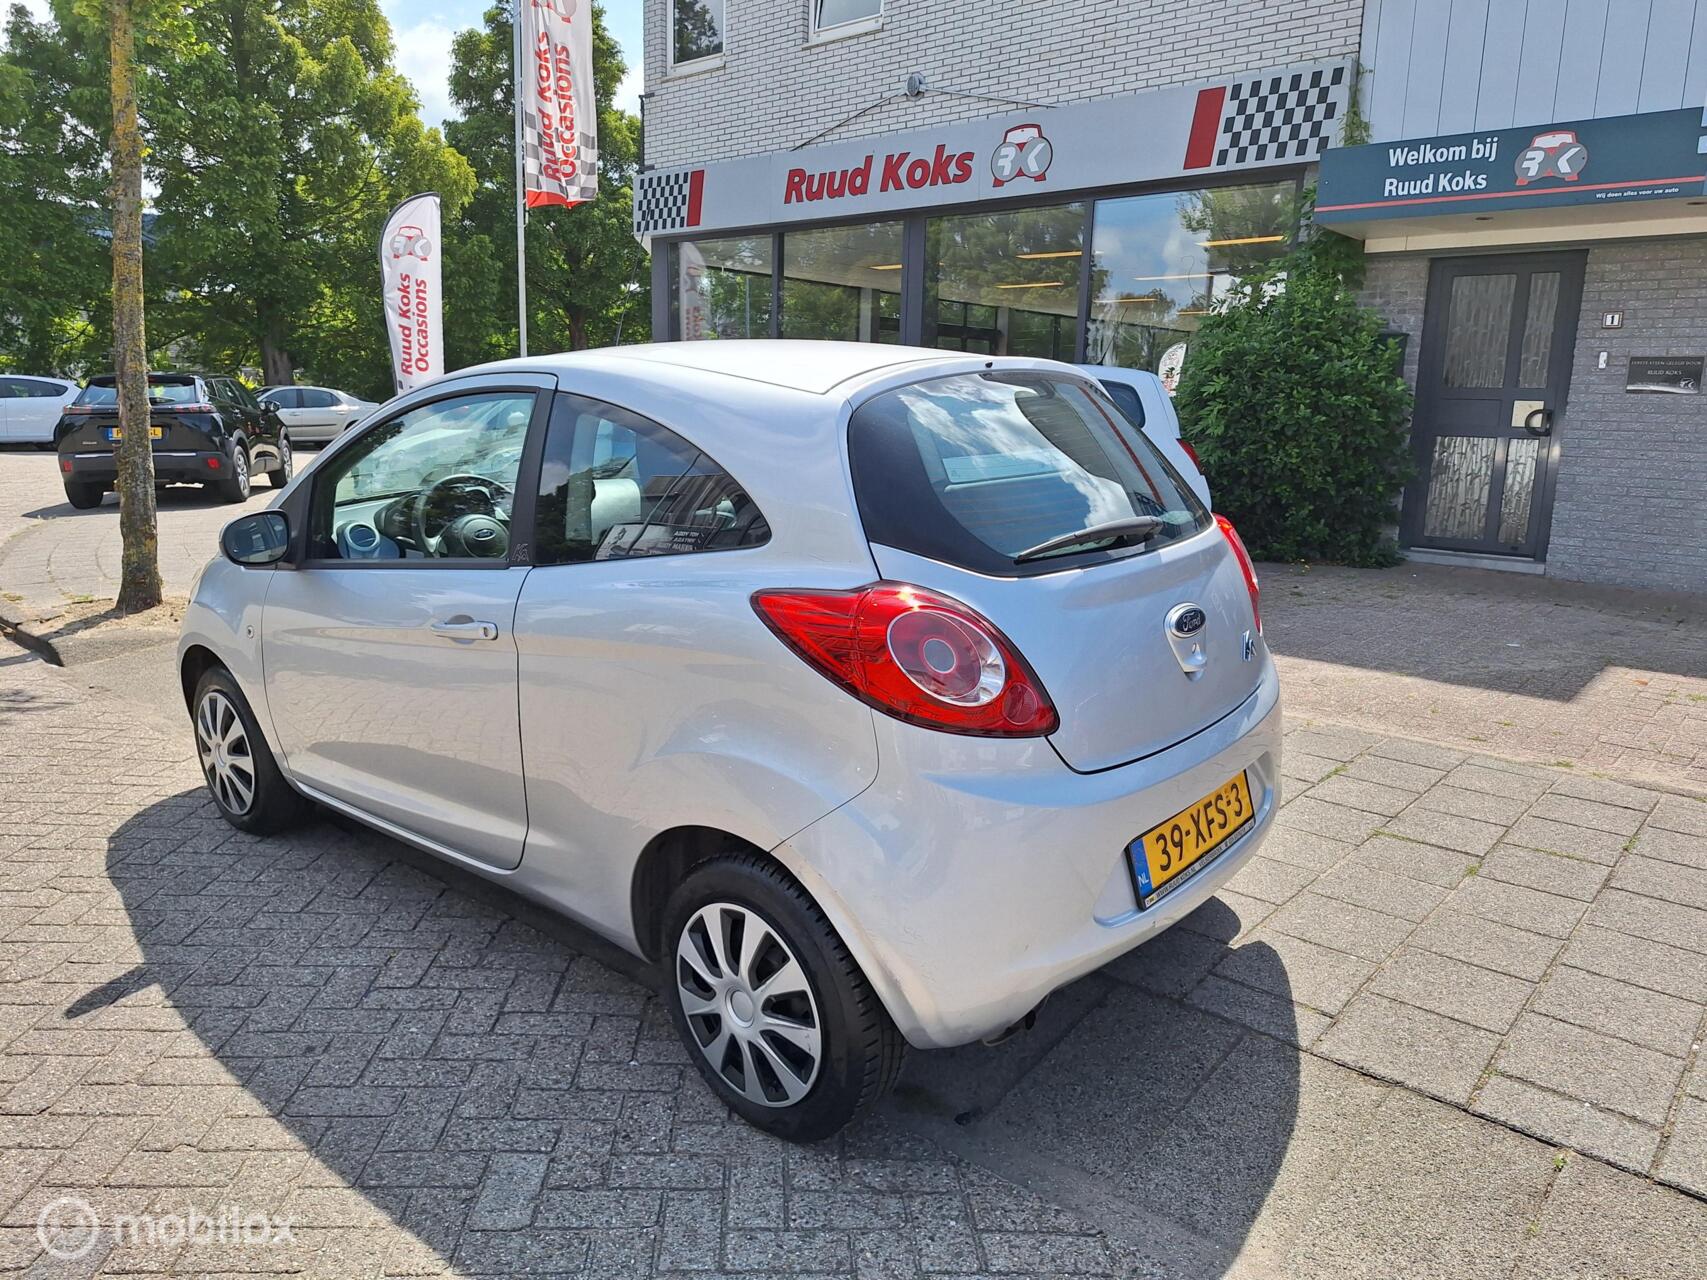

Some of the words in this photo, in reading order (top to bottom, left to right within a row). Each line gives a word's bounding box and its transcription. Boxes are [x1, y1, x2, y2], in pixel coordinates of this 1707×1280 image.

[535, 31, 553, 104] Koks
[554, 43, 577, 180] Occasions
[537, 106, 561, 183] Ruud
[1388, 143, 1466, 167] Welkom
[1471, 137, 1499, 162] bij
[783, 154, 874, 205] Ruud
[879, 144, 975, 193] Koks
[1384, 173, 1434, 197] Ruud
[1438, 170, 1488, 193] Koks
[397, 273, 411, 320] Koks
[399, 324, 413, 376] Ruud
[411, 278, 429, 373] Occasions
[1182, 611, 1202, 632] Ford
[1155, 783, 1244, 872] 39-XFS-3
[1138, 874, 1150, 888] NL
